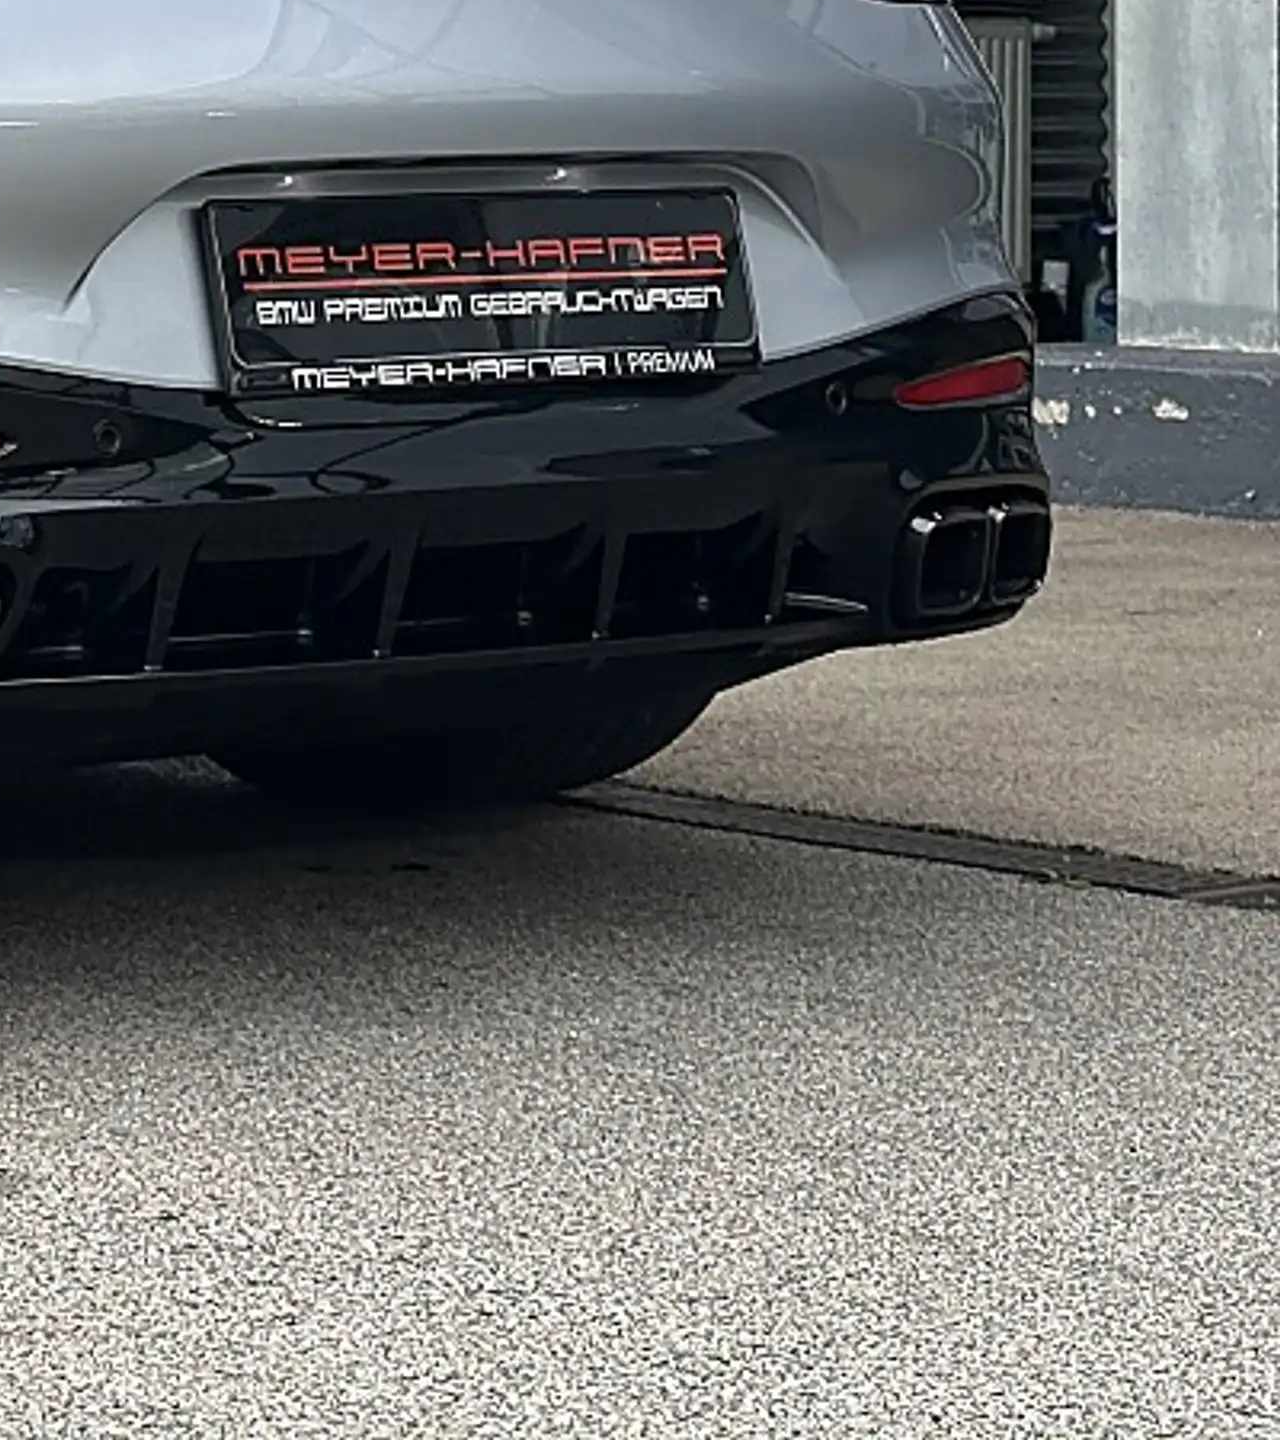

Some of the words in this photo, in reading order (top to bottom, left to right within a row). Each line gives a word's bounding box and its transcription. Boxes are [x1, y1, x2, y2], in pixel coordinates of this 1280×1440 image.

[237, 234, 725, 276] MEYER-HAFNER
[256, 300, 315, 325] BMW
[323, 294, 462, 322] PREMIUM
[470, 285, 724, 316] GEBRAUCHTWAGEN
[292, 355, 606, 390] MEYER-HAFNER
[627, 349, 715, 373] PREMIUM
